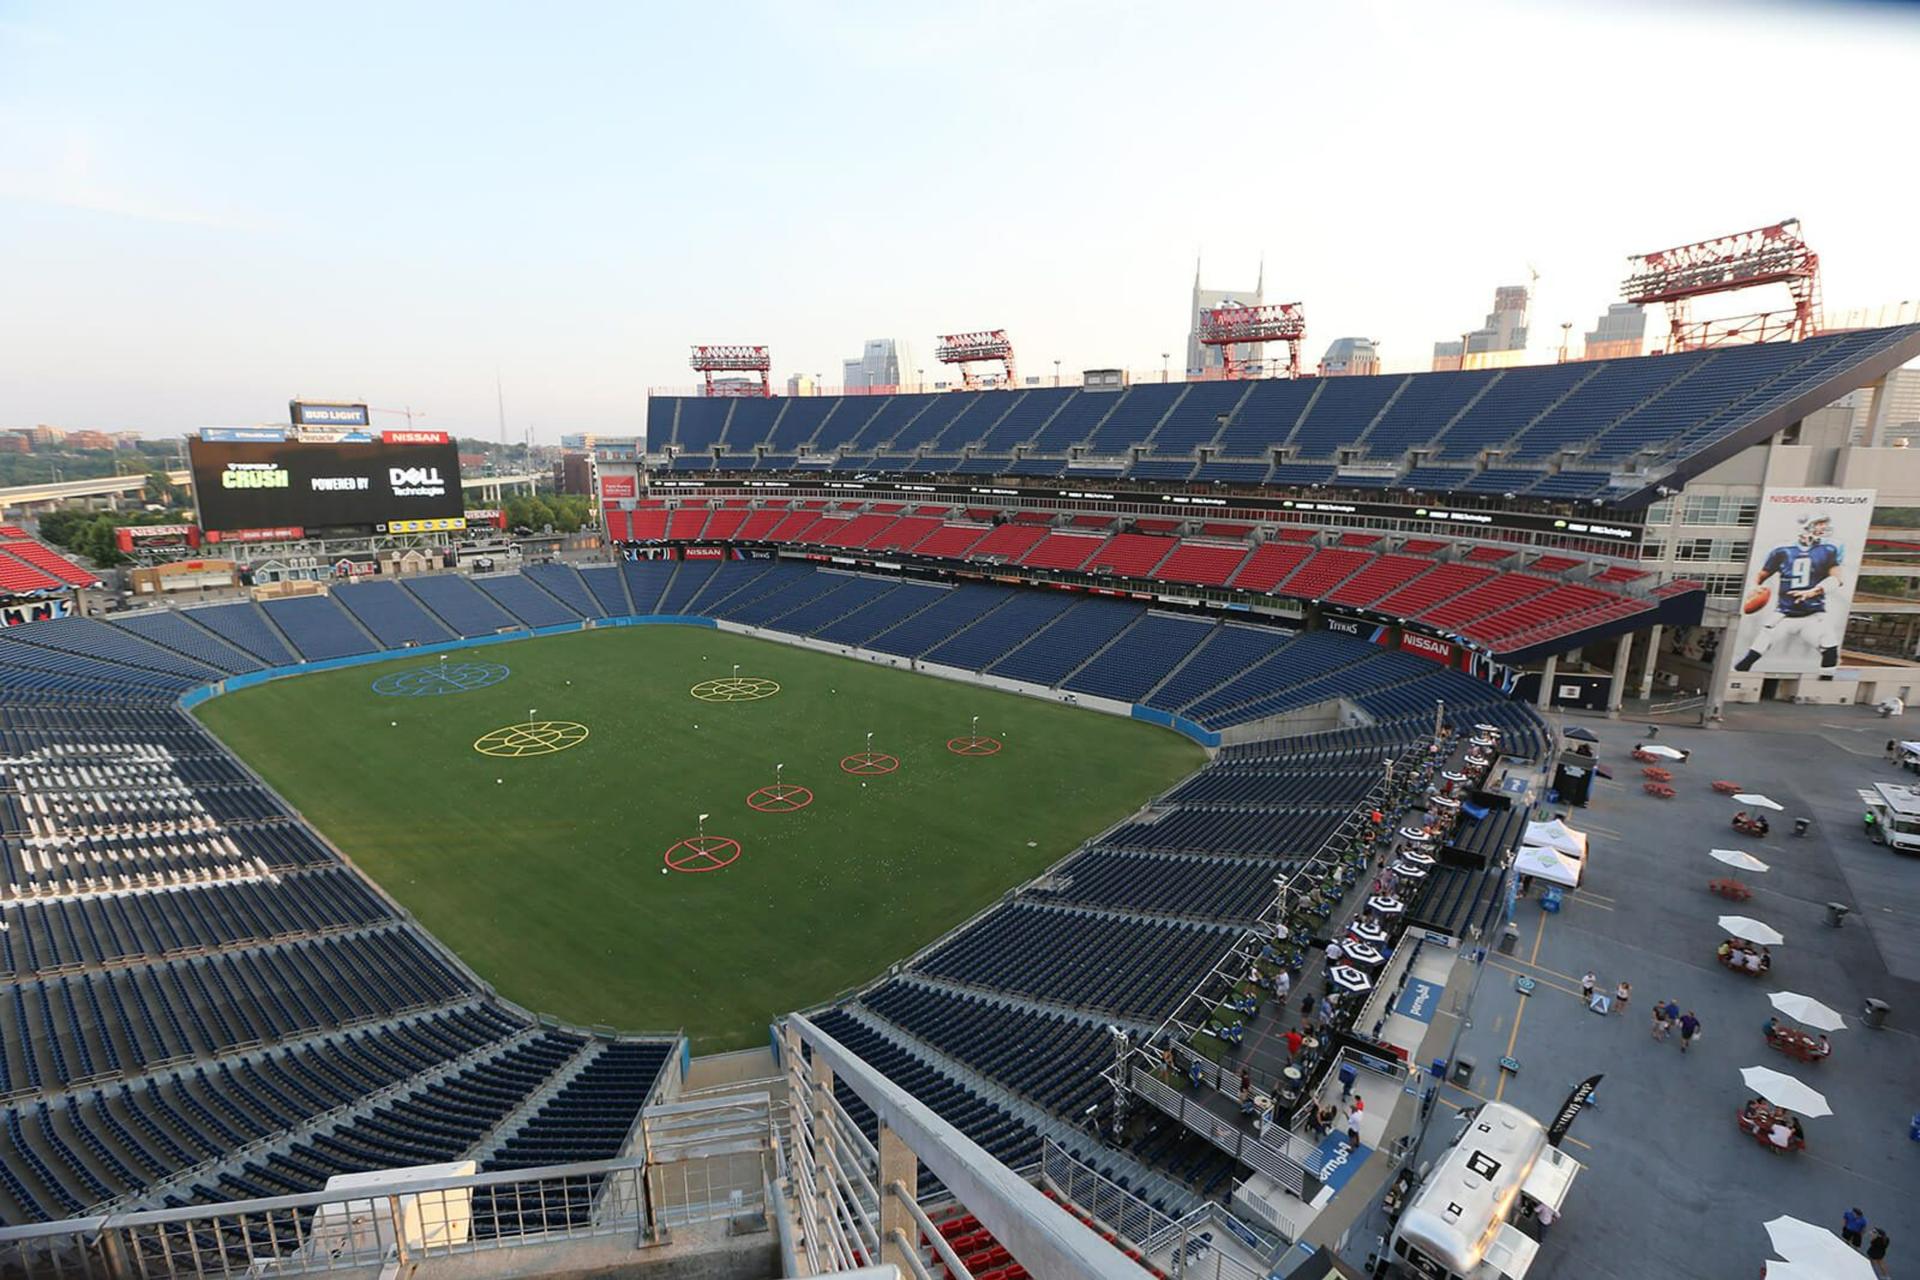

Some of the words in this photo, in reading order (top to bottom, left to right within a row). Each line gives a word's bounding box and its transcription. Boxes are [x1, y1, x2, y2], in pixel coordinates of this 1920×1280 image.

[330, 411, 361, 420] LIGHT
[392, 433, 440, 442] NISSAN
[222, 470, 288, 489] CRUSH
[389, 467, 444, 486] DELL
[311, 478, 356, 490] POWERED
[392, 486, 446, 497] Technologies
[130, 527, 188, 537] NISSAN
[1404, 633, 1450, 656] NISSAN
